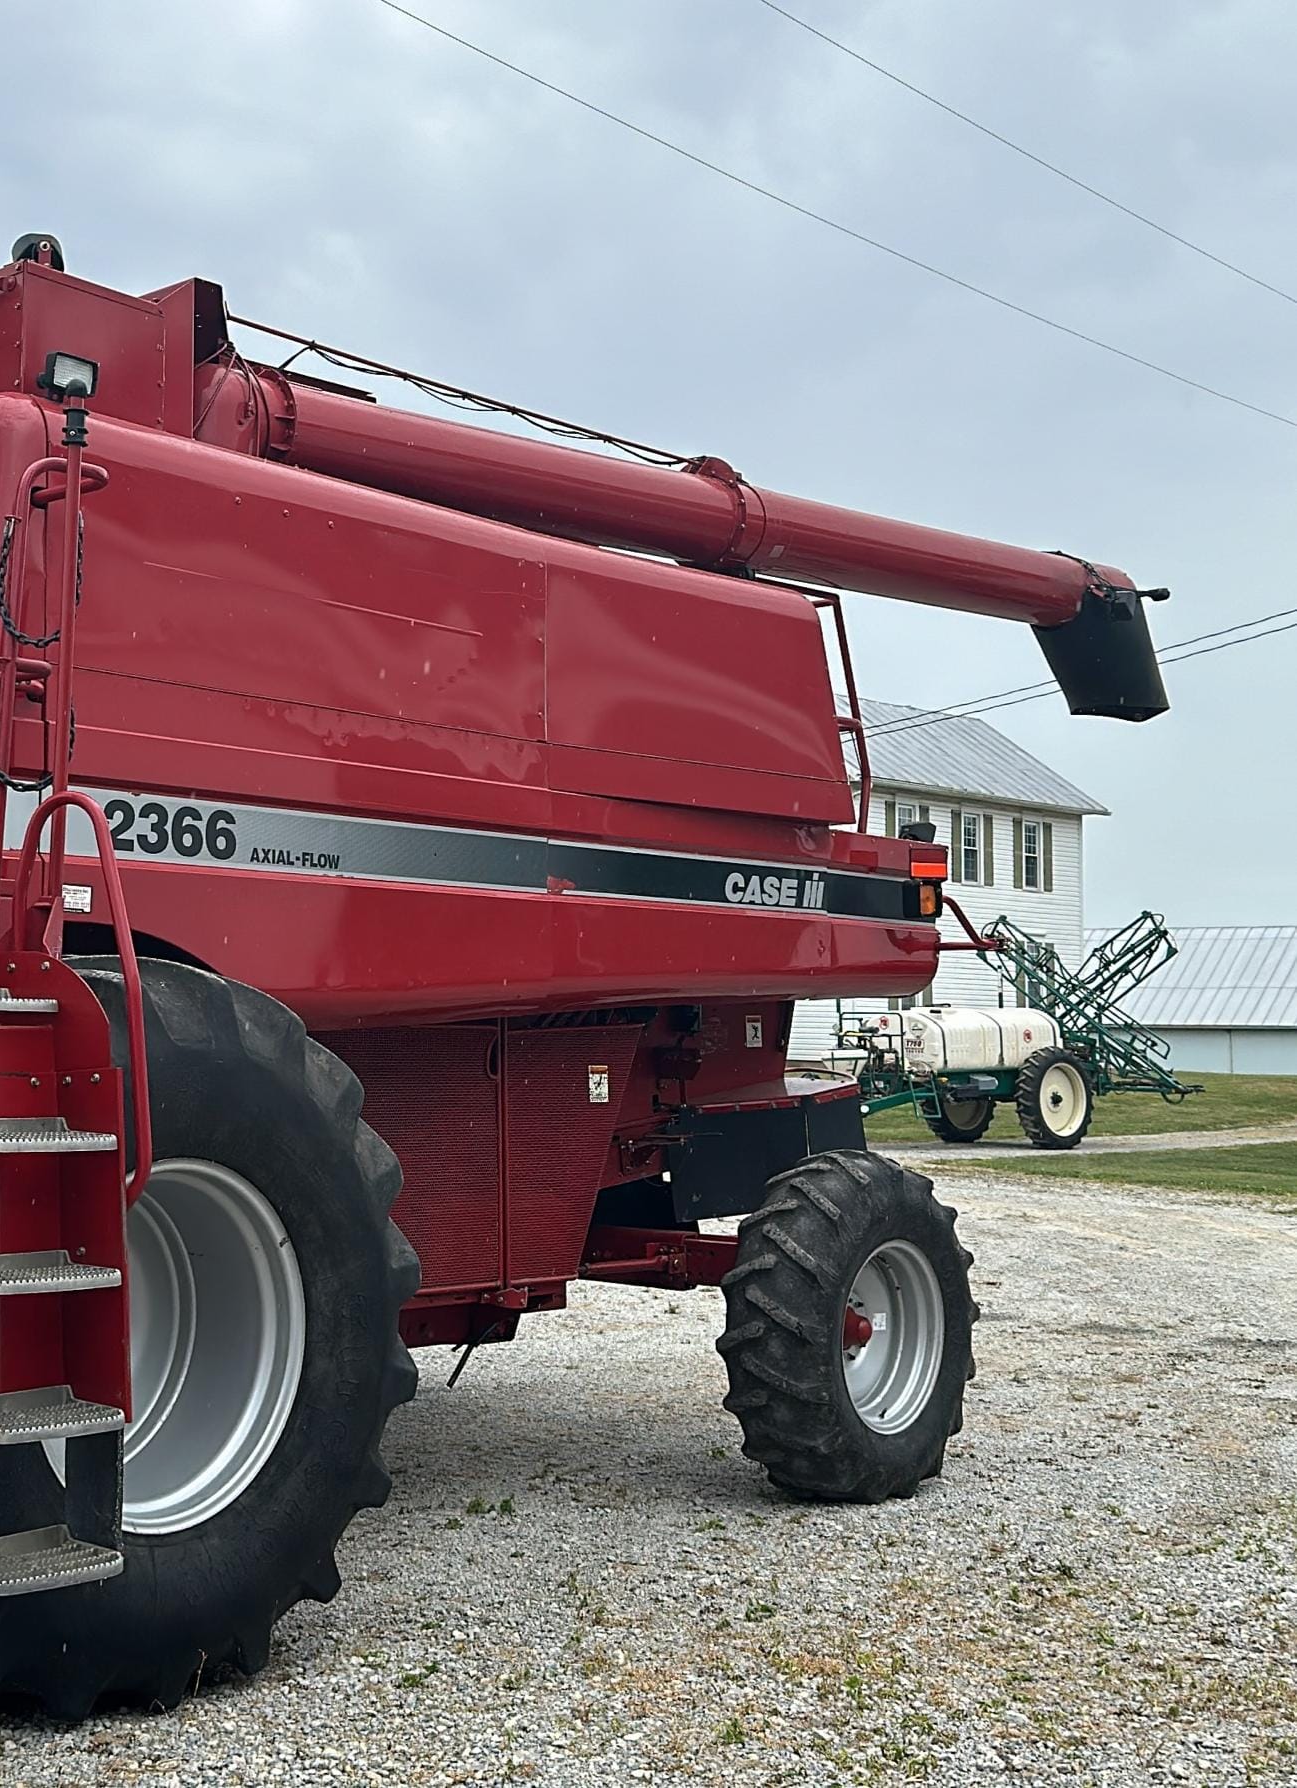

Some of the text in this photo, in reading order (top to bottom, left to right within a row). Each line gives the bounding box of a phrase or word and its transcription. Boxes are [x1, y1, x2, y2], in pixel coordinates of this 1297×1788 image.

[104, 799, 236, 860] 2366
[250, 848, 339, 869] AXIAL-FLOW
[725, 872, 798, 906] CASE
